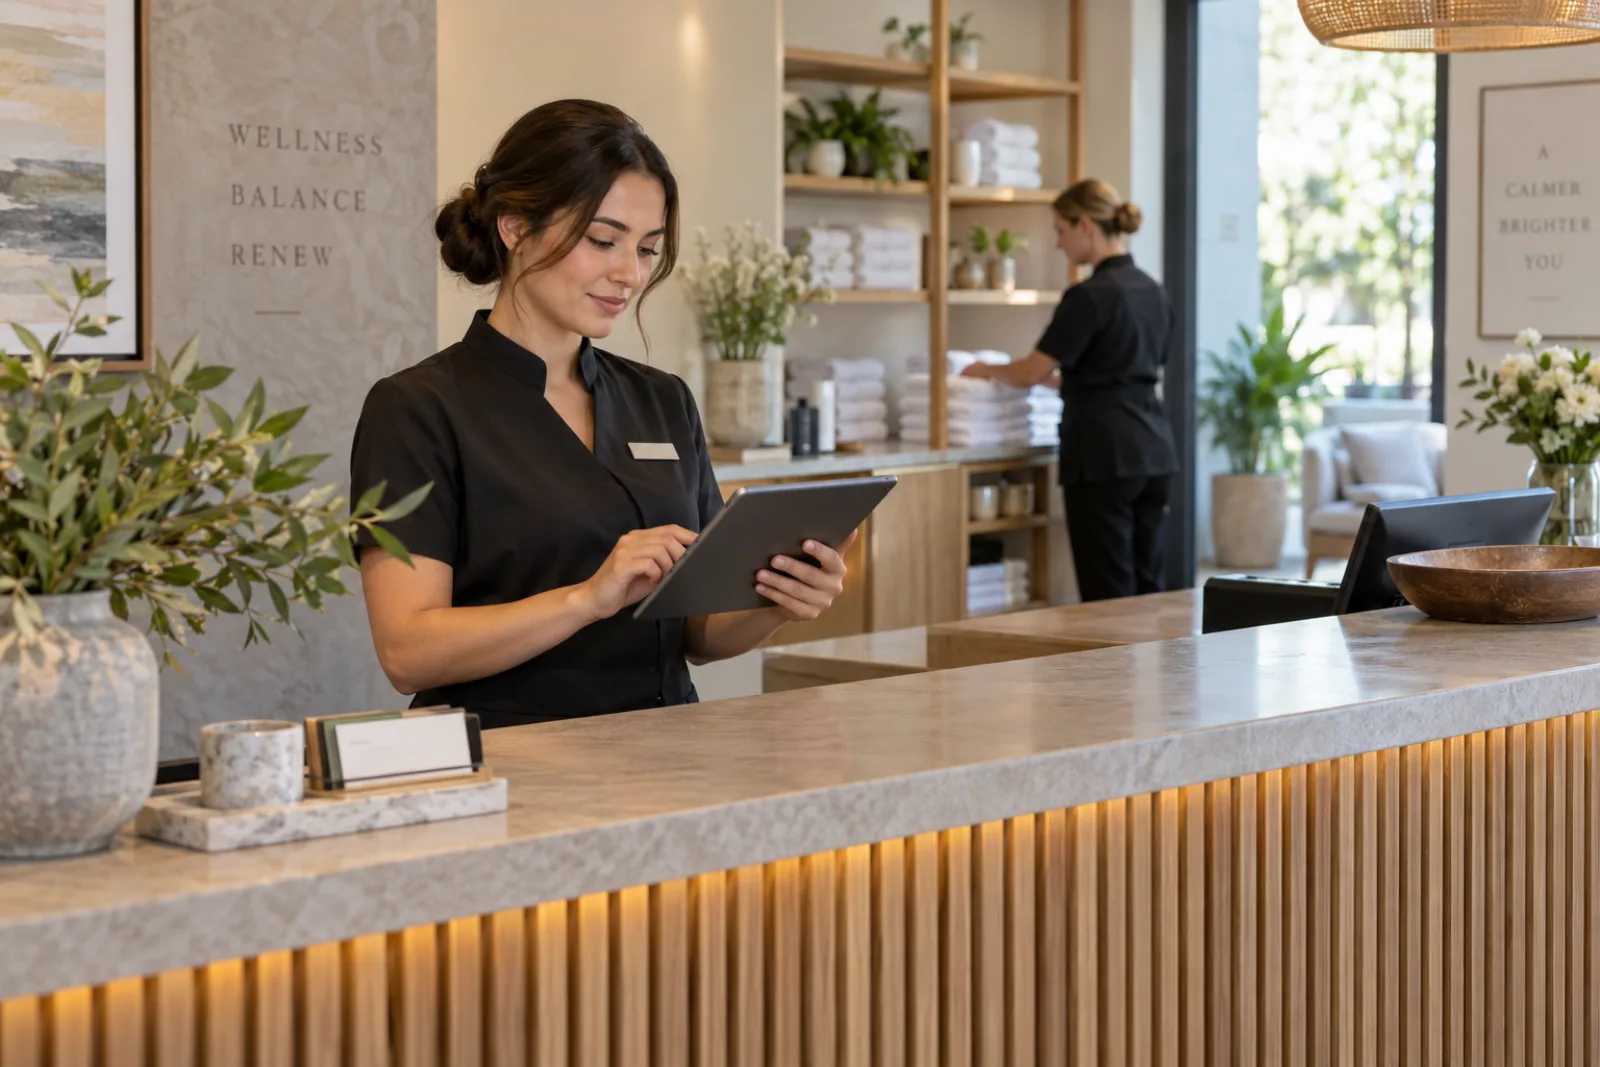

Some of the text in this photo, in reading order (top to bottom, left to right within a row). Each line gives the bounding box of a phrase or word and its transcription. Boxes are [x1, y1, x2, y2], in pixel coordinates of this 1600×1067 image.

[229, 123, 383, 156] WELLNESS
[1537, 145, 1550, 161] A
[231, 184, 367, 212] BALANCE
[1505, 181, 1581, 198] CALMER
[1499, 217, 1591, 235] BRIGHTER
[231, 244, 333, 267] RENEW
[1524, 254, 1563, 271] YOU
